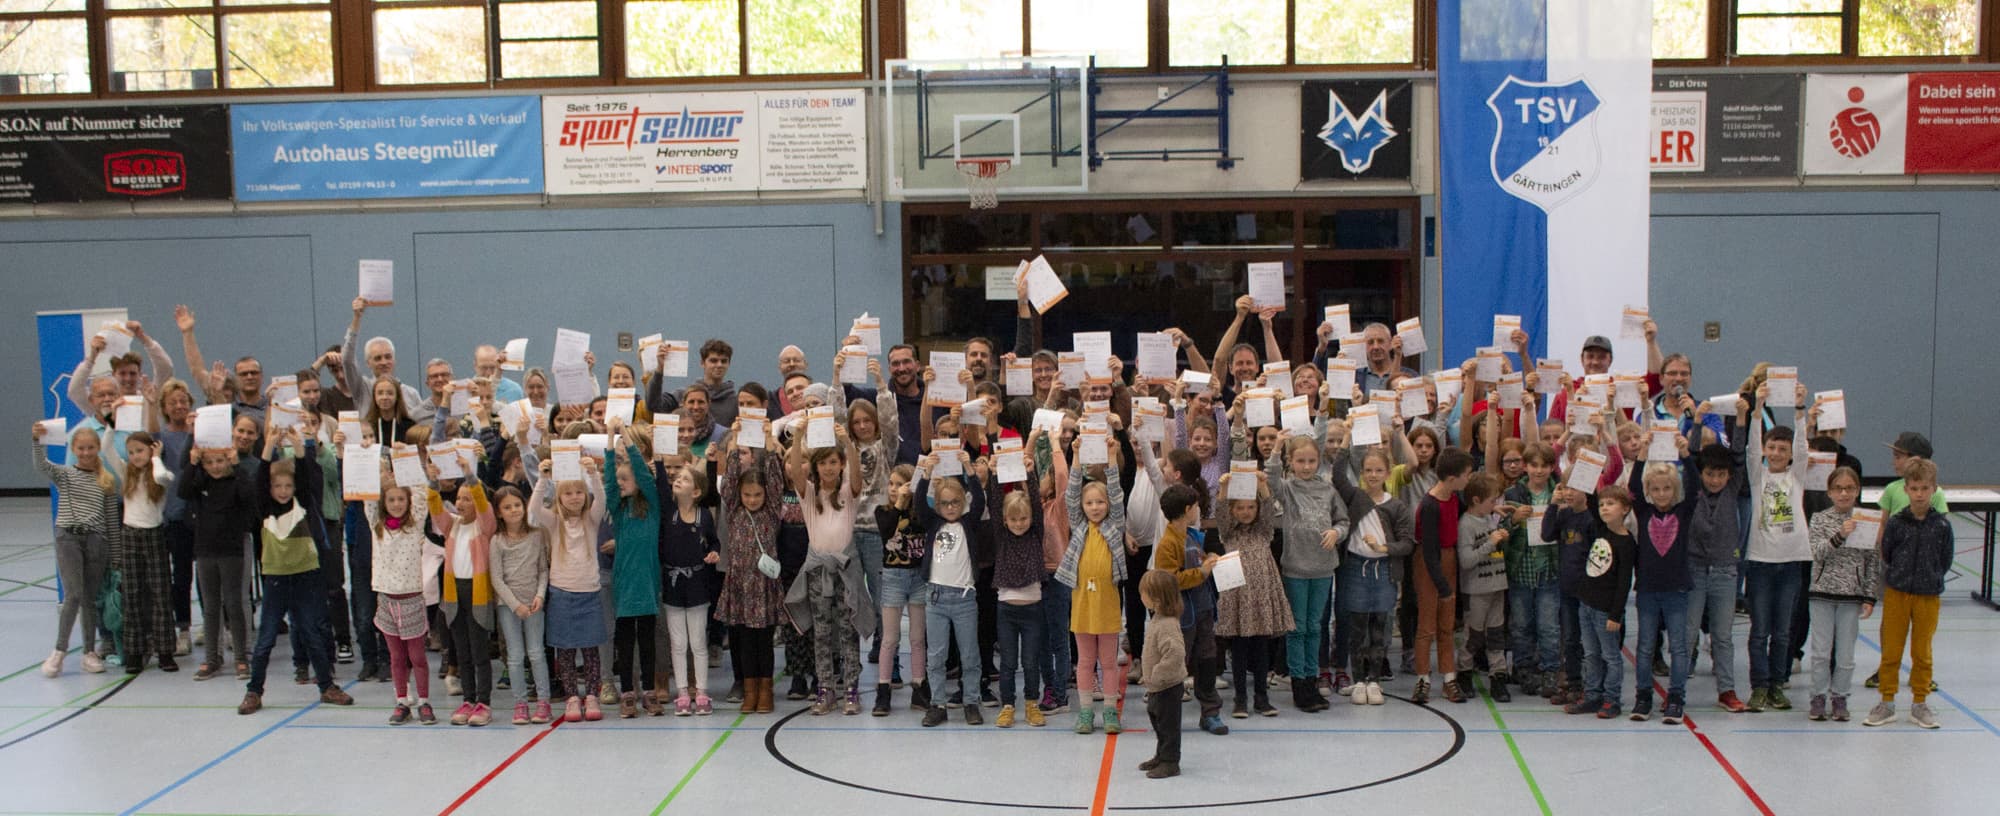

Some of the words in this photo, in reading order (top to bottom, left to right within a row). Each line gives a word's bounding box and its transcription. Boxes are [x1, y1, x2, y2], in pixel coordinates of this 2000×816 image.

[1669, 80, 1684, 88] DER
[1919, 84, 1962, 99] Dabei
[1965, 84, 1995, 99] sein
[567, 103, 592, 112] Seit
[594, 102, 628, 112] 1976
[764, 98, 791, 109] ALLES
[792, 97, 809, 108] FÜR
[810, 98, 829, 108] DEIN
[832, 97, 856, 108] TEAM!
[1514, 97, 1577, 124] TSV
[1659, 106, 1696, 116] HEIZUNG
[1918, 106, 1941, 115] Wenn
[1960, 106, 1982, 114] einen
[0, 117, 41, 132] S.O.N
[45, 116, 68, 131] auf
[72, 116, 136, 130] Nummer
[139, 115, 184, 129] sicher
[243, 120, 258, 132] Ihr
[262, 117, 395, 134] Volkswagen-Spezialist
[400, 115, 417, 129] für
[421, 115, 464, 128] Service
[467, 114, 476, 126] &
[479, 112, 528, 126] Verkauf
[640, 105, 744, 144] sehner
[1661, 117, 1677, 126] DAS
[1679, 117, 1696, 126] BAD
[1918, 117, 1931, 125] der
[1932, 116, 1954, 124] einen
[1955, 115, 1988, 126] sportlich
[1537, 136, 1549, 147] 19
[274, 144, 369, 163] Autohaus
[374, 140, 498, 164] Steegmüller
[656, 147, 739, 160] Herrenberg
[1547, 146, 1559, 155] 21
[112, 158, 178, 176] SON
[667, 164, 733, 175] INTERSPORT
[112, 175, 180, 185] SECURITY
[1512, 170, 1582, 193] GÄRTRINGEN
